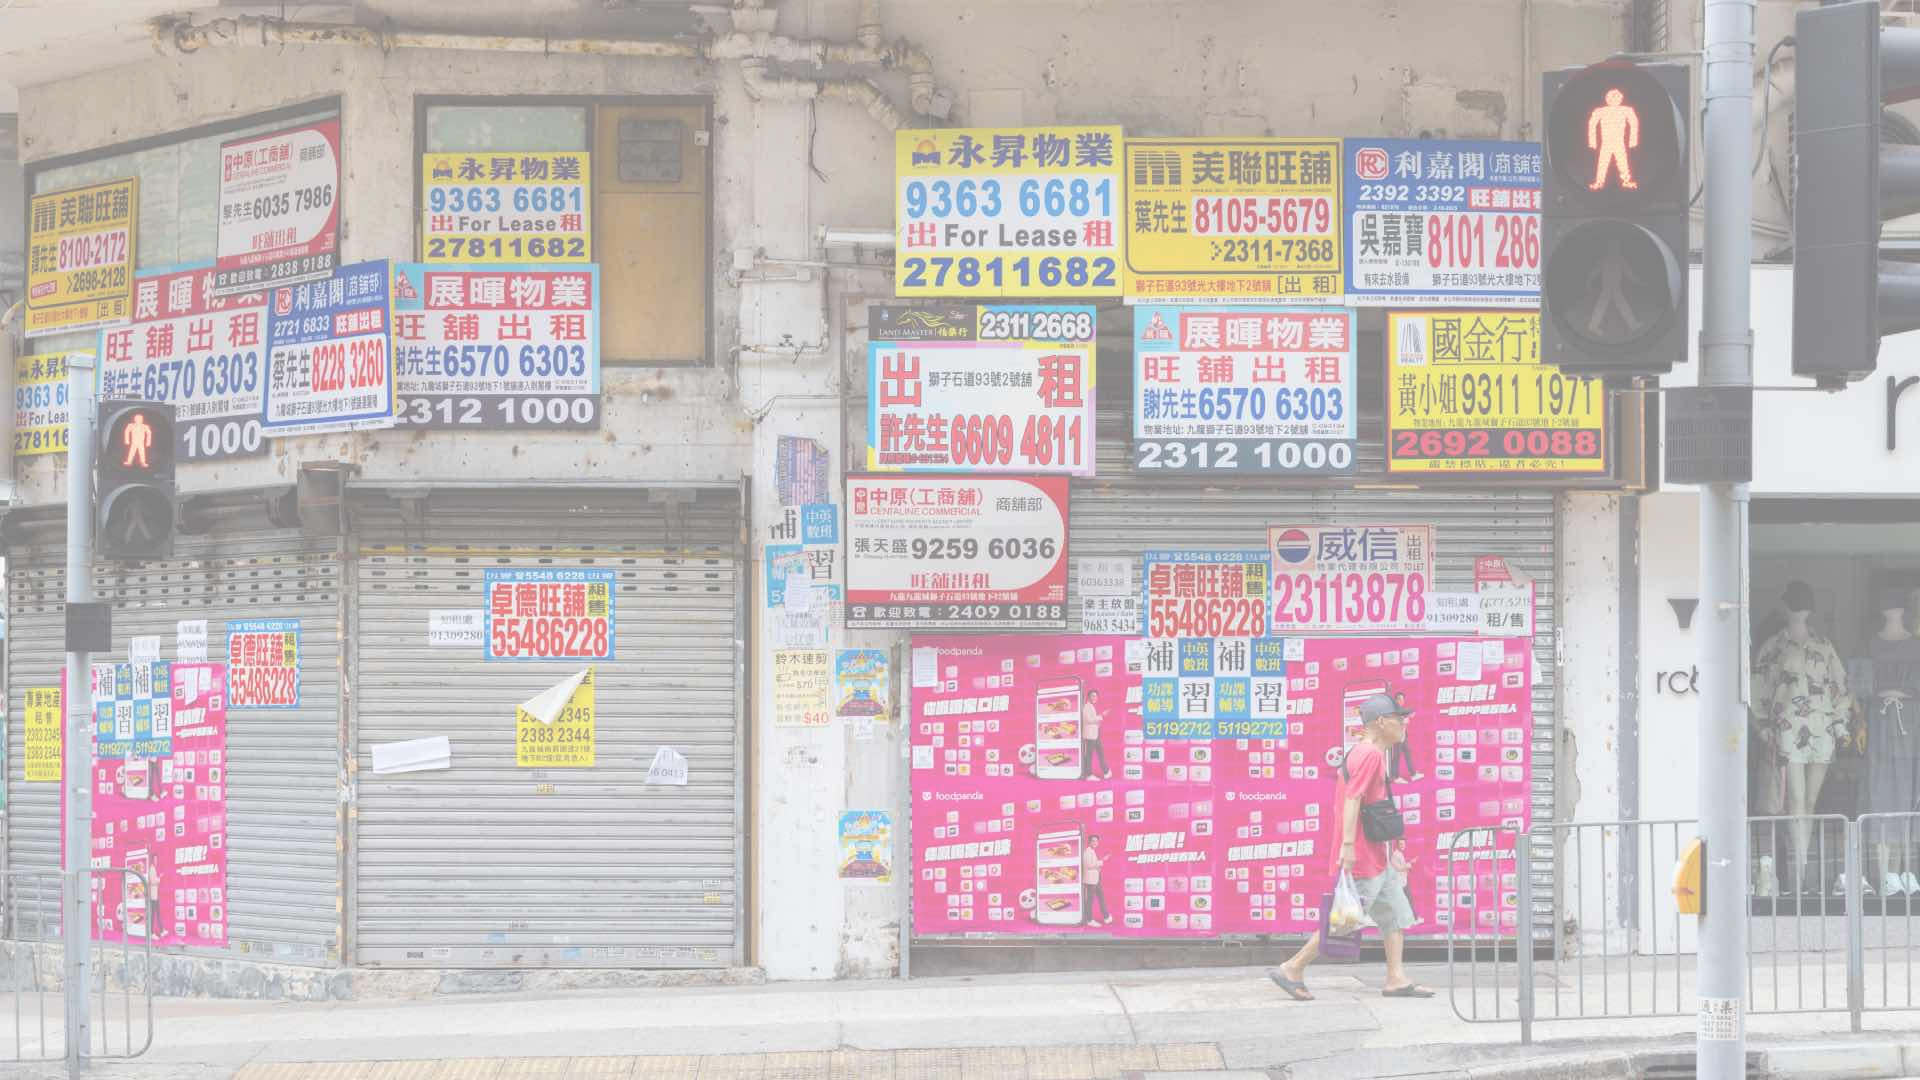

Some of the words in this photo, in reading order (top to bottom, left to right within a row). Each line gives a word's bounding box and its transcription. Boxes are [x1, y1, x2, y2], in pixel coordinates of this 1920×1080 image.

[948, 132, 1114, 168] 永昇物業
[458, 156, 580, 180] 永昇物業
[1192, 150, 1332, 185] 美聯旺舖
[1395, 151, 1484, 180] 利嘉閣
[60, 187, 128, 227] 美聯旺舖
[254, 192, 290, 220] 6035
[294, 184, 332, 213] 7986
[430, 186, 500, 212] 9363
[514, 186, 582, 212] 6681
[906, 180, 1002, 218] 9363
[1019, 178, 1110, 217] 6681
[1360, 184, 1409, 201] 2392
[1416, 184, 1464, 202] 3392
[431, 214, 453, 232] 出
[458, 217, 492, 231] For
[498, 216, 556, 231] Lease
[560, 214, 582, 231] 租
[1135, 199, 1187, 234] 葉先生
[1195, 198, 1330, 233] 8105-5679
[428, 238, 585, 258] 27811682
[908, 222, 936, 248] 出
[944, 224, 988, 247] For
[999, 224, 1077, 247] Lease
[1082, 220, 1114, 248] 租
[1360, 214, 1424, 256] 吳嘉寶
[1428, 215, 1484, 268] 8101
[58, 231, 126, 270] 8100-2172
[1223, 239, 1334, 262] 2311-7368
[72, 266, 126, 292] 2698-2128
[271, 261, 298, 278] 2838
[302, 254, 332, 273] 9188
[902, 256, 1116, 287] 27811682
[295, 278, 344, 310] 利嘉閣
[429, 276, 586, 307] 展暉物業
[106, 312, 259, 362] 旺舖出租
[274, 320, 300, 337] 2721
[303, 316, 330, 334] 6833
[395, 314, 587, 340] 旺舖出租
[980, 312, 1030, 339] 2311
[1032, 312, 1092, 339] 2668
[1184, 317, 1345, 349] 展暉物業
[1432, 316, 1527, 362] 國金行
[272, 350, 310, 390] 蔡先生
[312, 344, 346, 392] 8228
[349, 338, 384, 388] 3260
[444, 344, 510, 377] 6570
[520, 344, 586, 377] 6303
[1144, 356, 1342, 384] 旺舖出租
[144, 359, 196, 400] 6570
[202, 351, 258, 398] 6303
[880, 352, 922, 407] 出
[928, 372, 1032, 388] 獅子石道93號2號舖
[1037, 354, 1084, 408] 租
[16, 384, 50, 410] 9363
[1144, 388, 1198, 420] 謝先生
[1200, 387, 1266, 420] 6570
[1276, 387, 1344, 420] 6303
[1398, 373, 1458, 416] 黃小姐
[1462, 373, 1519, 415] 9311
[1536, 373, 1594, 415] 1971
[396, 398, 482, 424] 2312
[498, 398, 594, 424] 1000
[183, 419, 262, 457] 1000
[880, 413, 948, 451] 許先生
[950, 414, 1014, 465] 6609
[1020, 414, 1082, 466] 4811
[1396, 430, 1490, 456] 2692
[1503, 430, 1596, 456] 0088
[1138, 442, 1238, 468] 2312
[1254, 442, 1352, 468] 1000
[870, 487, 984, 506] 中原(工商舖)
[996, 498, 1043, 512] 商舖部
[921, 508, 982, 516] COMMERCIAL
[854, 538, 908, 554] 張天盛
[911, 538, 978, 560] 9259
[988, 538, 1056, 560] 6036
[1317, 528, 1399, 561] 威信
[1407, 534, 1422, 561] 出租
[911, 573, 992, 589] 旺舖出租
[1150, 564, 1244, 598] 卓德旺舖
[492, 583, 586, 616] 卓德旺舖
[948, 606, 1000, 619] 2409
[1009, 606, 1062, 619] 0188
[1274, 572, 1425, 624] 23113878
[1084, 618, 1108, 632] 9683
[1110, 618, 1136, 632] 5434
[1150, 599, 1265, 638] 55486228
[1426, 612, 1479, 624] 91309280
[1486, 612, 1524, 627] 租/售
[430, 631, 484, 640] 91309280
[492, 618, 608, 657] 55486228
[231, 634, 284, 667] 卓德旺舖
[1144, 640, 1172, 672] 補
[1217, 640, 1246, 672] 補
[231, 668, 296, 704] 55486228
[1183, 682, 1210, 713] 習
[1255, 682, 1282, 713] 習
[558, 708, 590, 722] 2345
[804, 712, 830, 724] $40
[1146, 722, 1211, 736] 51192712
[1218, 722, 1282, 736] 51192712
[520, 728, 554, 742] 2383
[558, 728, 590, 742] 2344
[936, 792, 984, 800] foodpanda
[1239, 792, 1287, 800] foodpanda
